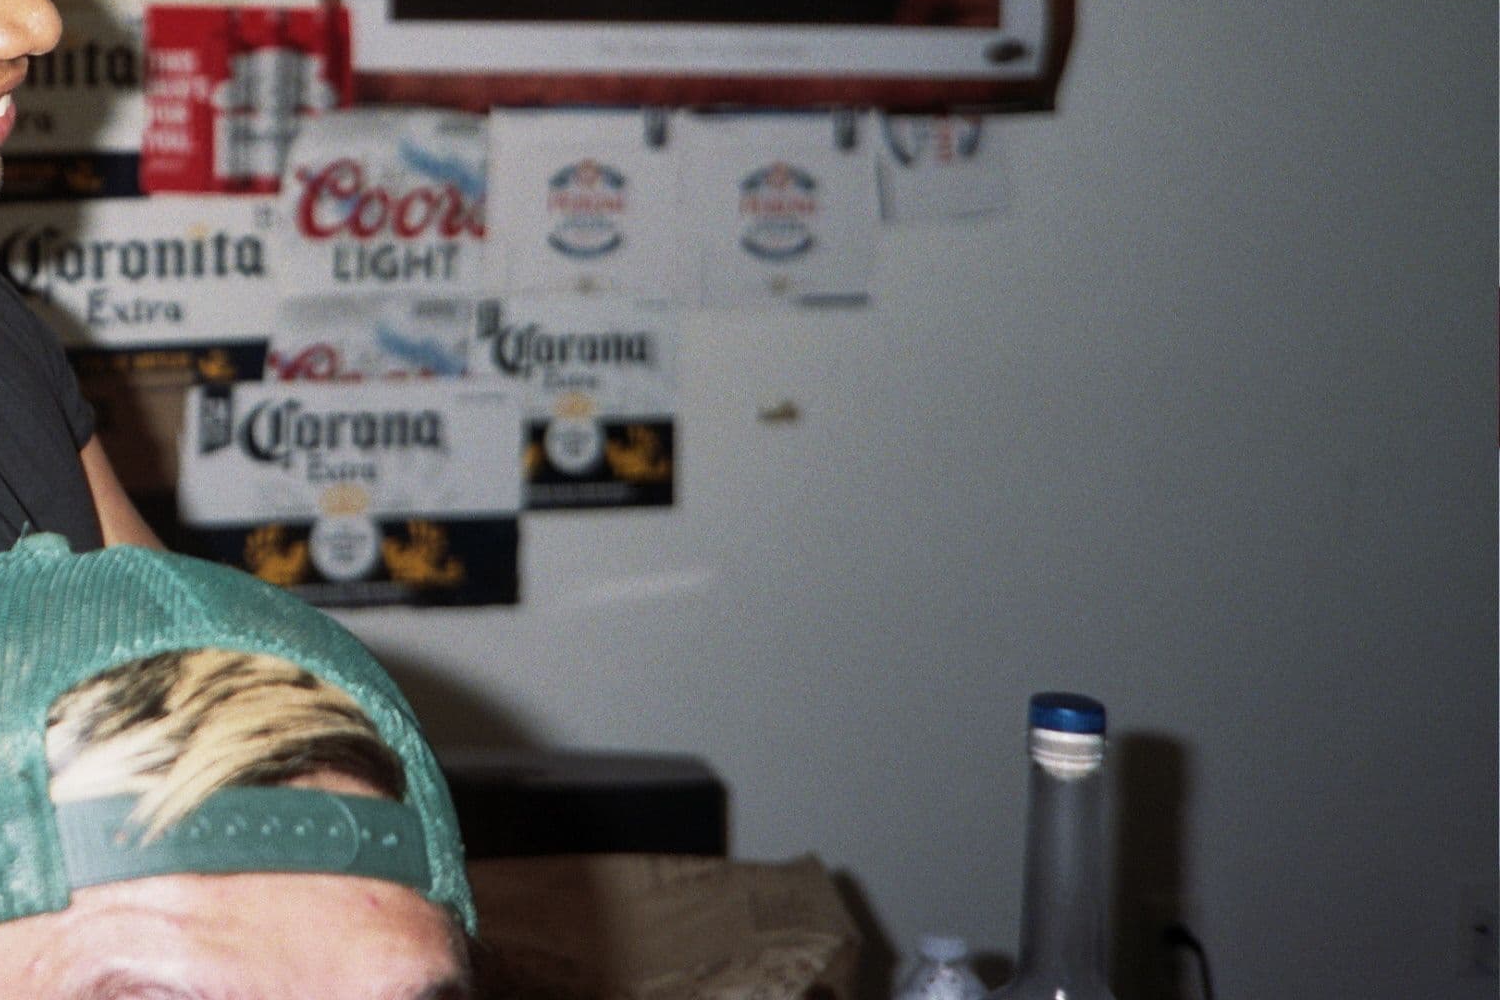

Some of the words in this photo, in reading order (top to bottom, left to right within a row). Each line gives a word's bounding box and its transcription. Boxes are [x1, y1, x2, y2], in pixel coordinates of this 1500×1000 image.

[332, 243, 459, 283] LIGHT
[87, 288, 186, 326] Extra
[492, 321, 653, 377] Corona
[240, 399, 448, 467] Corona
